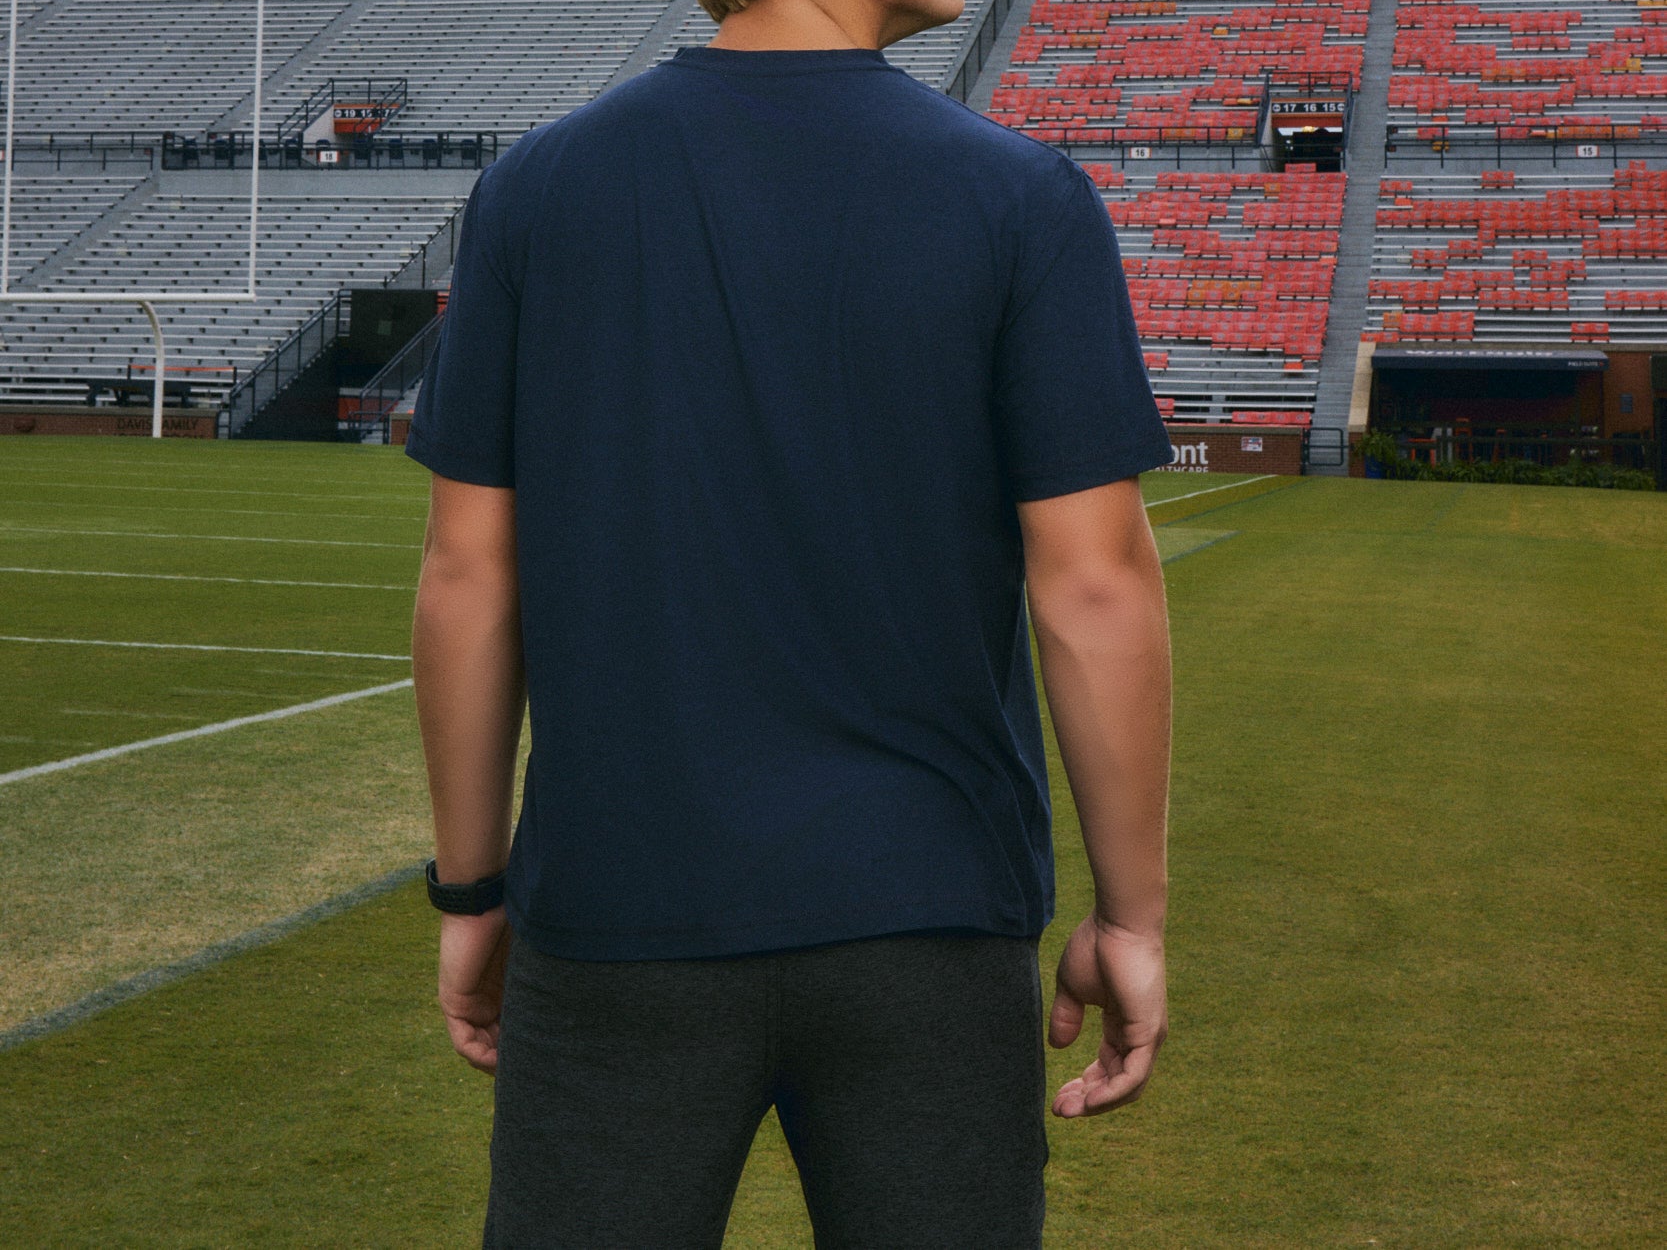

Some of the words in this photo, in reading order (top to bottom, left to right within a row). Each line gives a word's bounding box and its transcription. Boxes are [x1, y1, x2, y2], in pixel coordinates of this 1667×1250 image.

[1283, 103, 1297, 112] 17
[1303, 103, 1317, 112] 16
[1322, 103, 1336, 112] 15
[162, 418, 199, 430] AMILY
